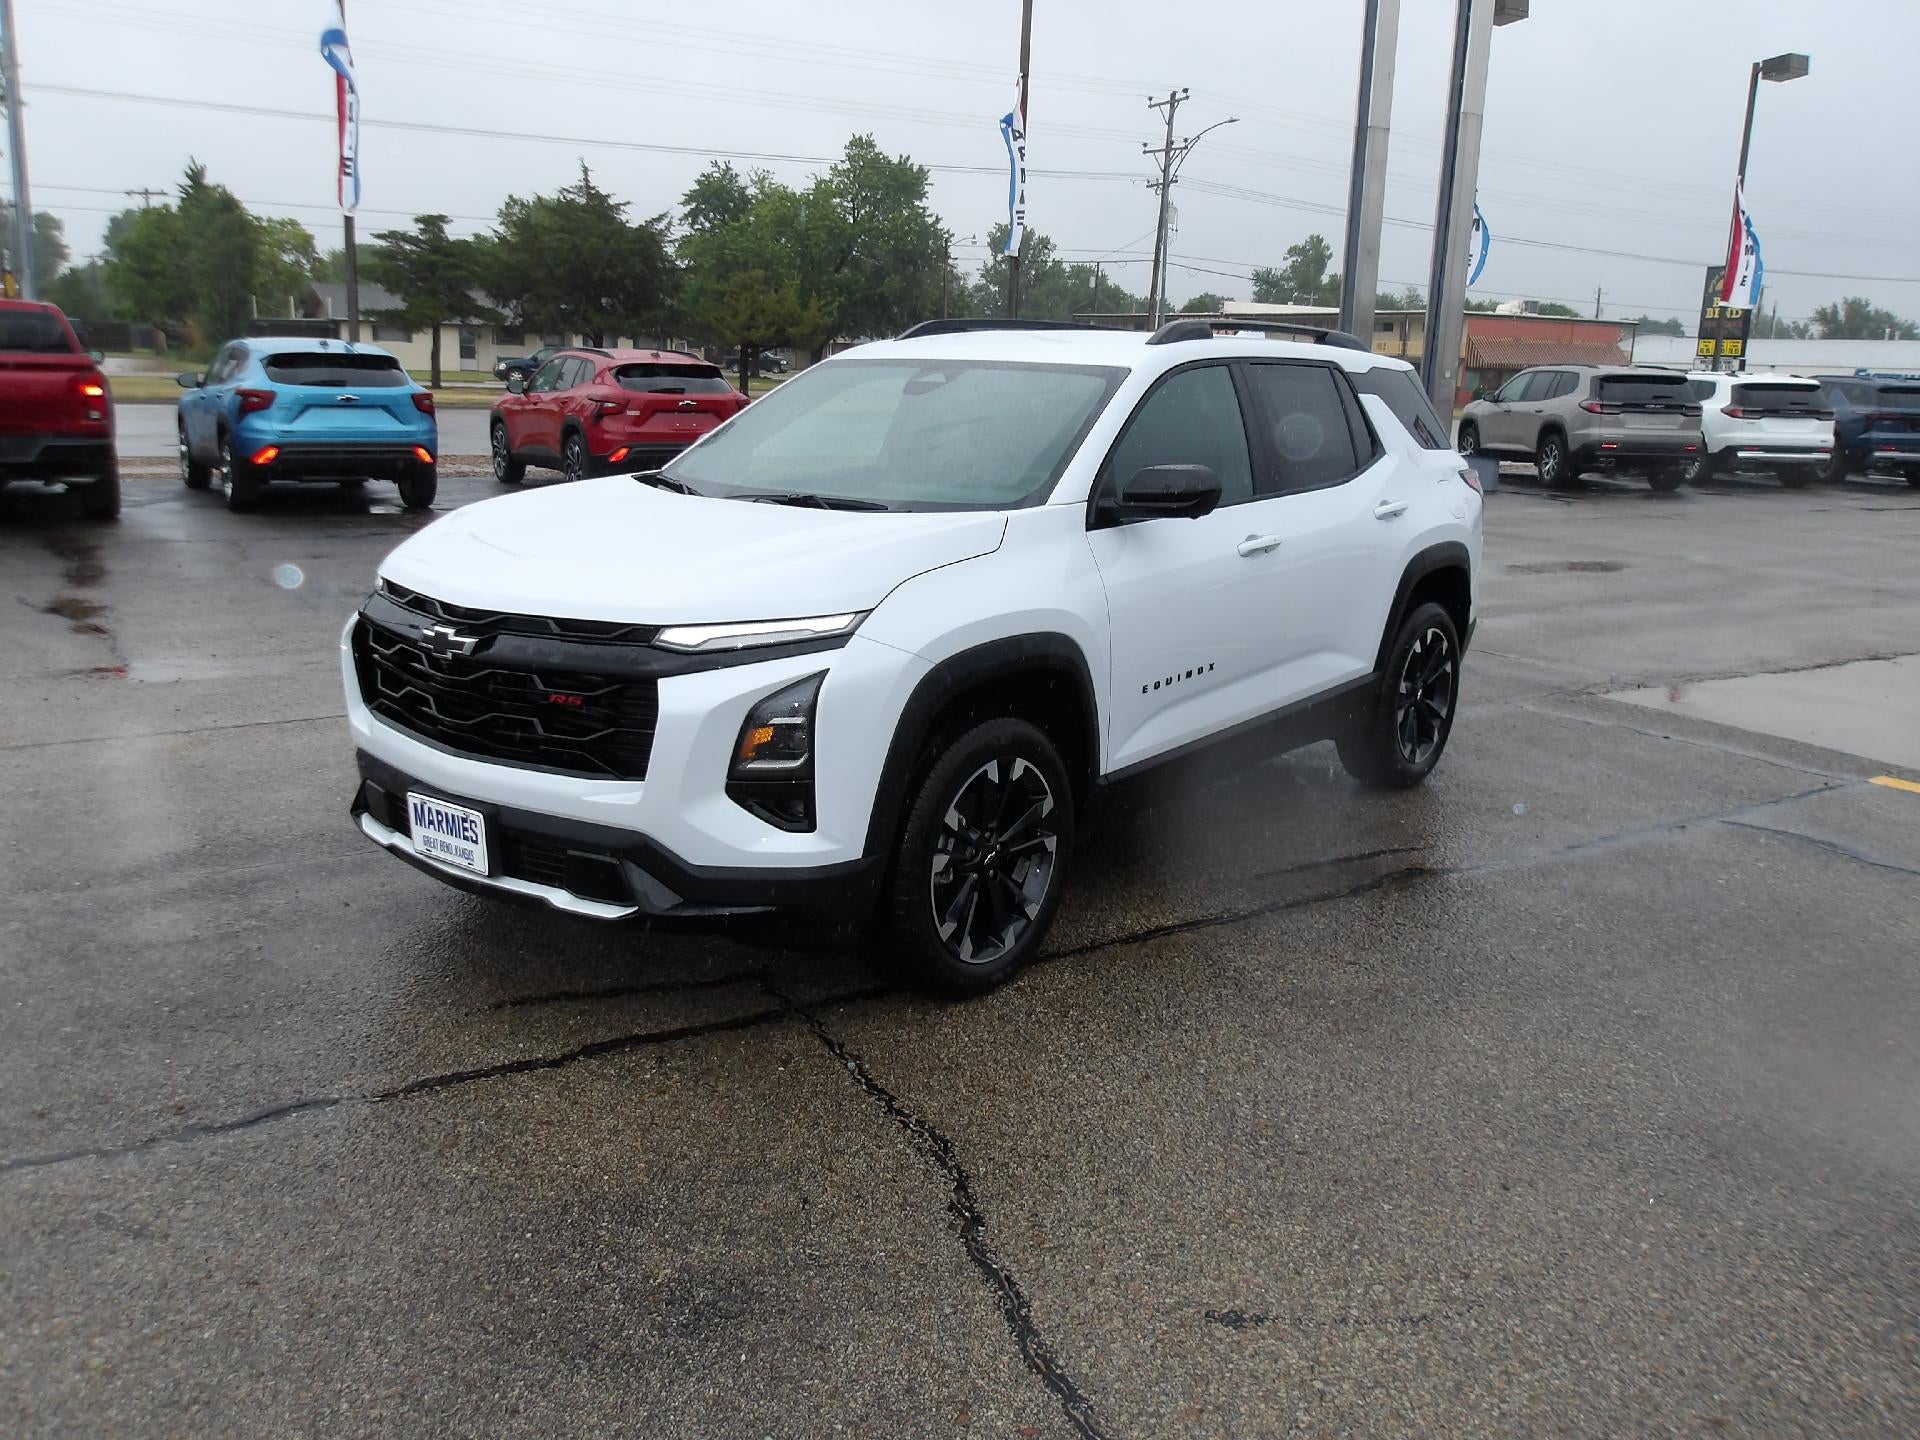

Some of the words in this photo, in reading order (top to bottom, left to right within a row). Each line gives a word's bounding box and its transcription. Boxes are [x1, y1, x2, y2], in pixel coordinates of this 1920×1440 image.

[1142, 662, 1215, 694] EQUINOX
[549, 694, 582, 706] RS
[413, 802, 479, 845] MARMIES
[423, 835, 438, 850] GREAT
[454, 845, 475, 862] KANSAS
